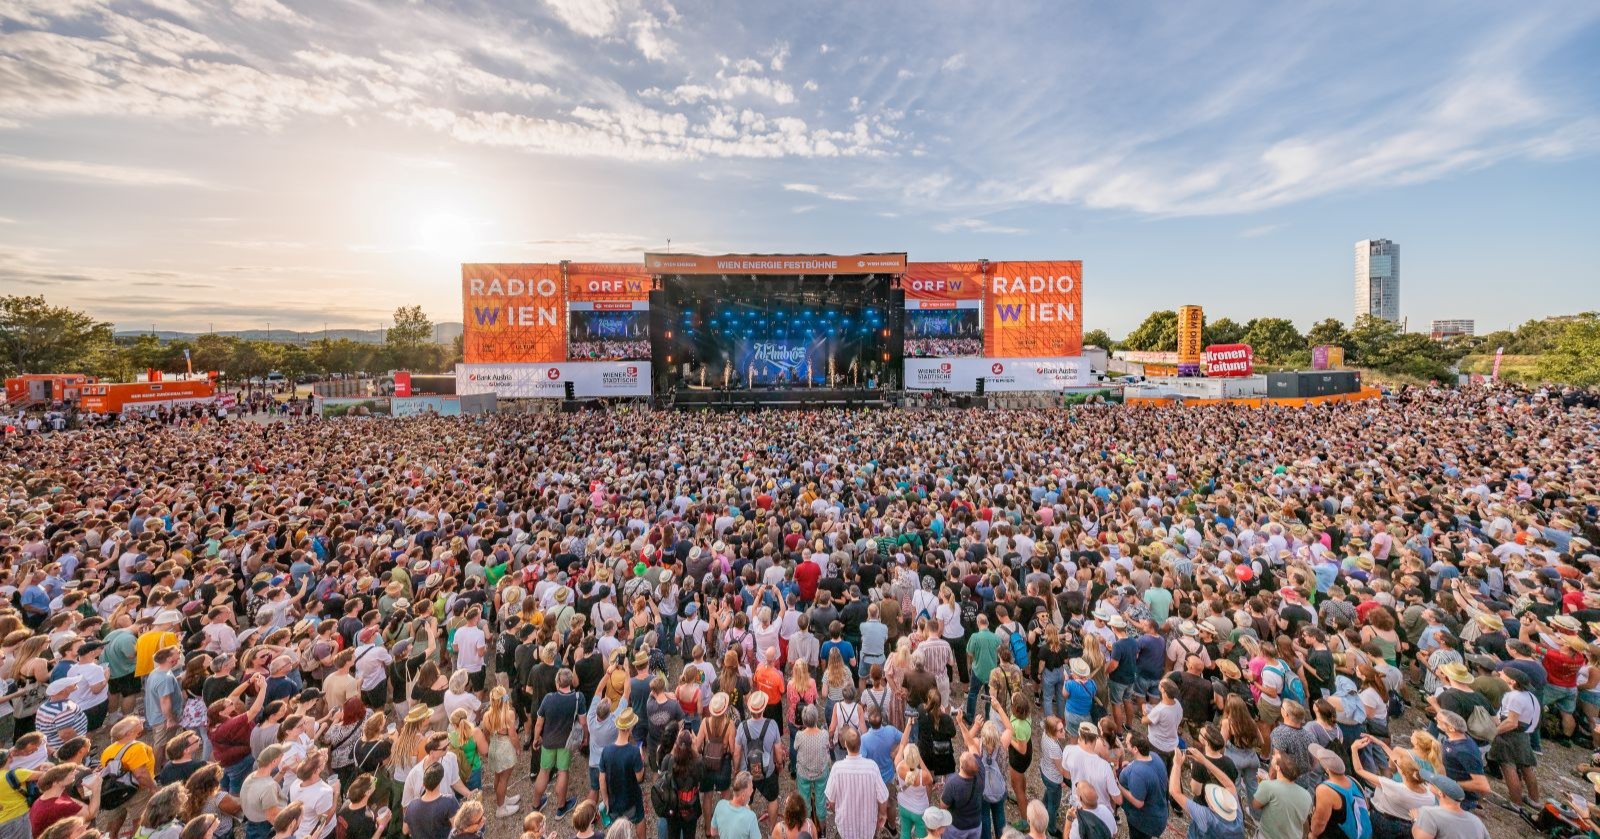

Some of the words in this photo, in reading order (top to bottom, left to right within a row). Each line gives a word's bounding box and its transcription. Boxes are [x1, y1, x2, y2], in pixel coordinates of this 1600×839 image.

[717, 261, 740, 269] WIEN
[743, 261, 782, 269] ENERGIE
[784, 260, 837, 269] FESTBÜHNE
[470, 278, 556, 297] RADIO
[588, 280, 623, 292] ORF
[912, 280, 945, 291] ORF
[993, 276, 1074, 294] RADIO
[474, 306, 557, 326] WIEN
[996, 303, 1074, 322] WIEN
[1206, 349, 1246, 362] Kronen
[1207, 360, 1247, 373] Zeitung
